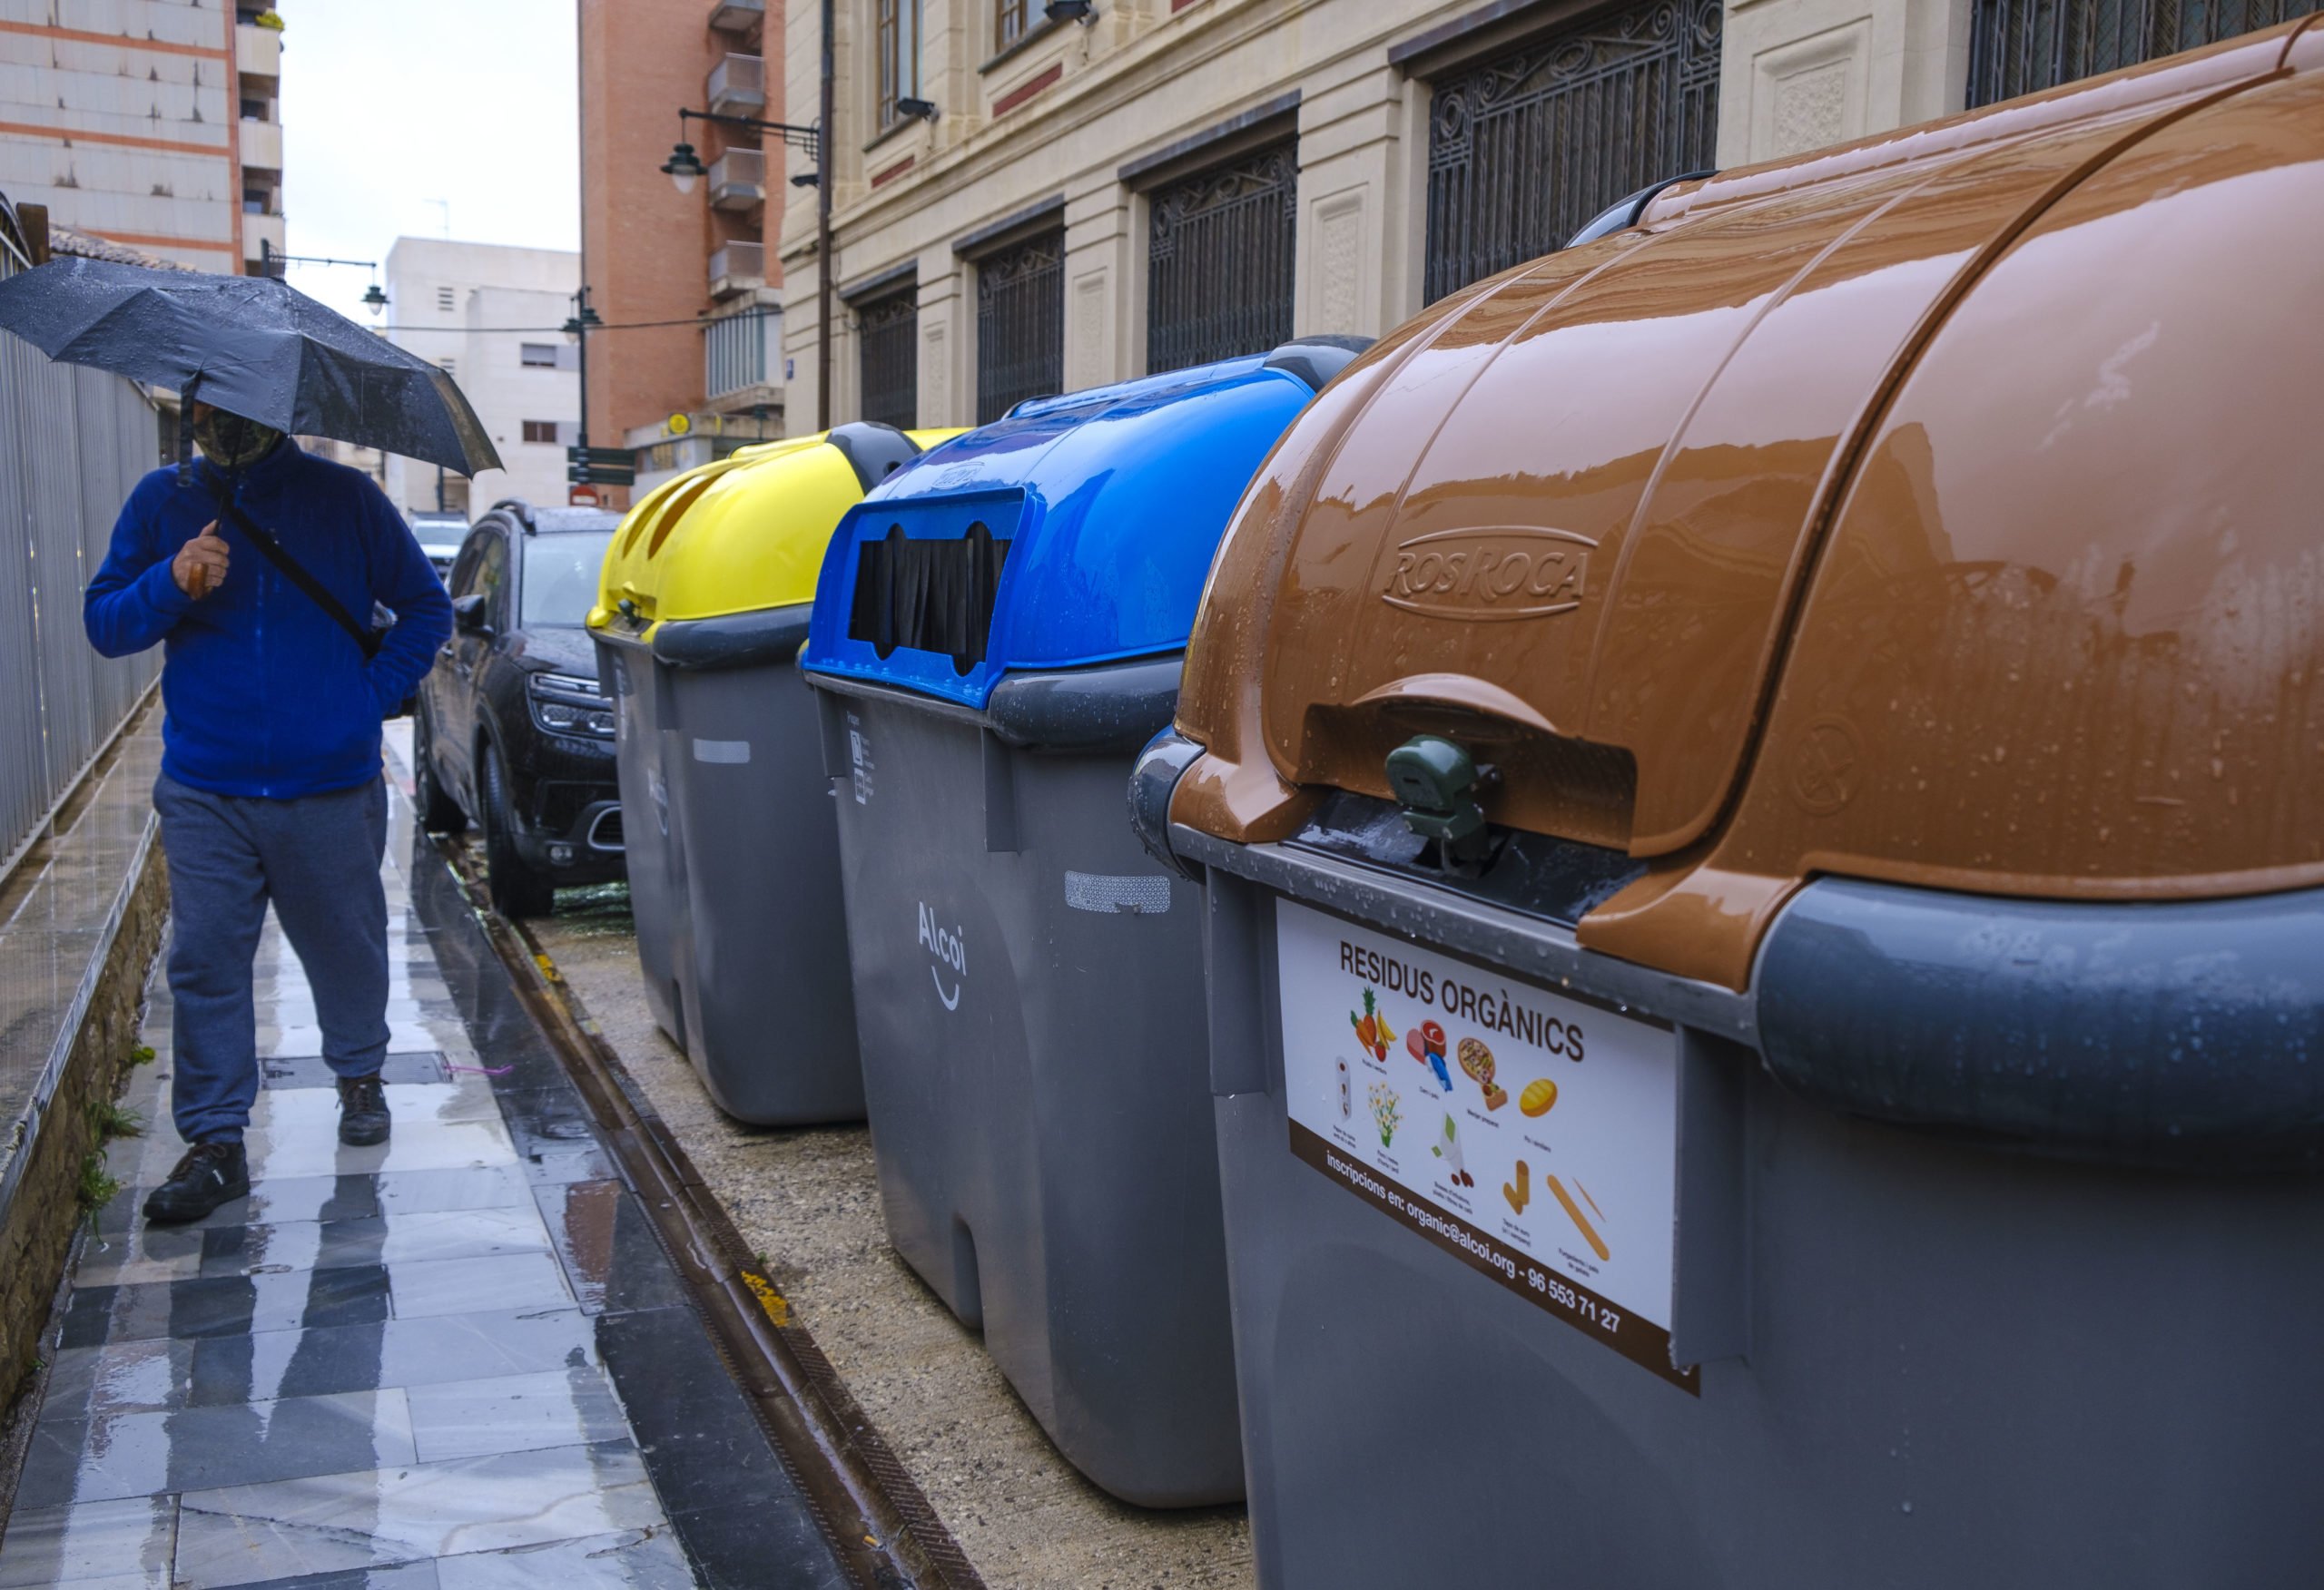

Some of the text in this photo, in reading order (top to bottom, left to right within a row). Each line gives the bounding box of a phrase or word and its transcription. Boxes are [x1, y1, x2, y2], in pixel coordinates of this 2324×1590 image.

[919, 900, 967, 977] Alcoi
[1340, 940, 1584, 1063] RESIDUS ORGÀNICS
[1326, 1150, 1386, 1200] inscripcions
[1387, 1191, 1405, 1212] en:
[1407, 1202, 1515, 1280] organic@alcoi.org
[1528, 1268, 1546, 1292] 96
[1548, 1280, 1576, 1309] 553
[1578, 1295, 1596, 1321] 71
[1600, 1308, 1620, 1333] 27
